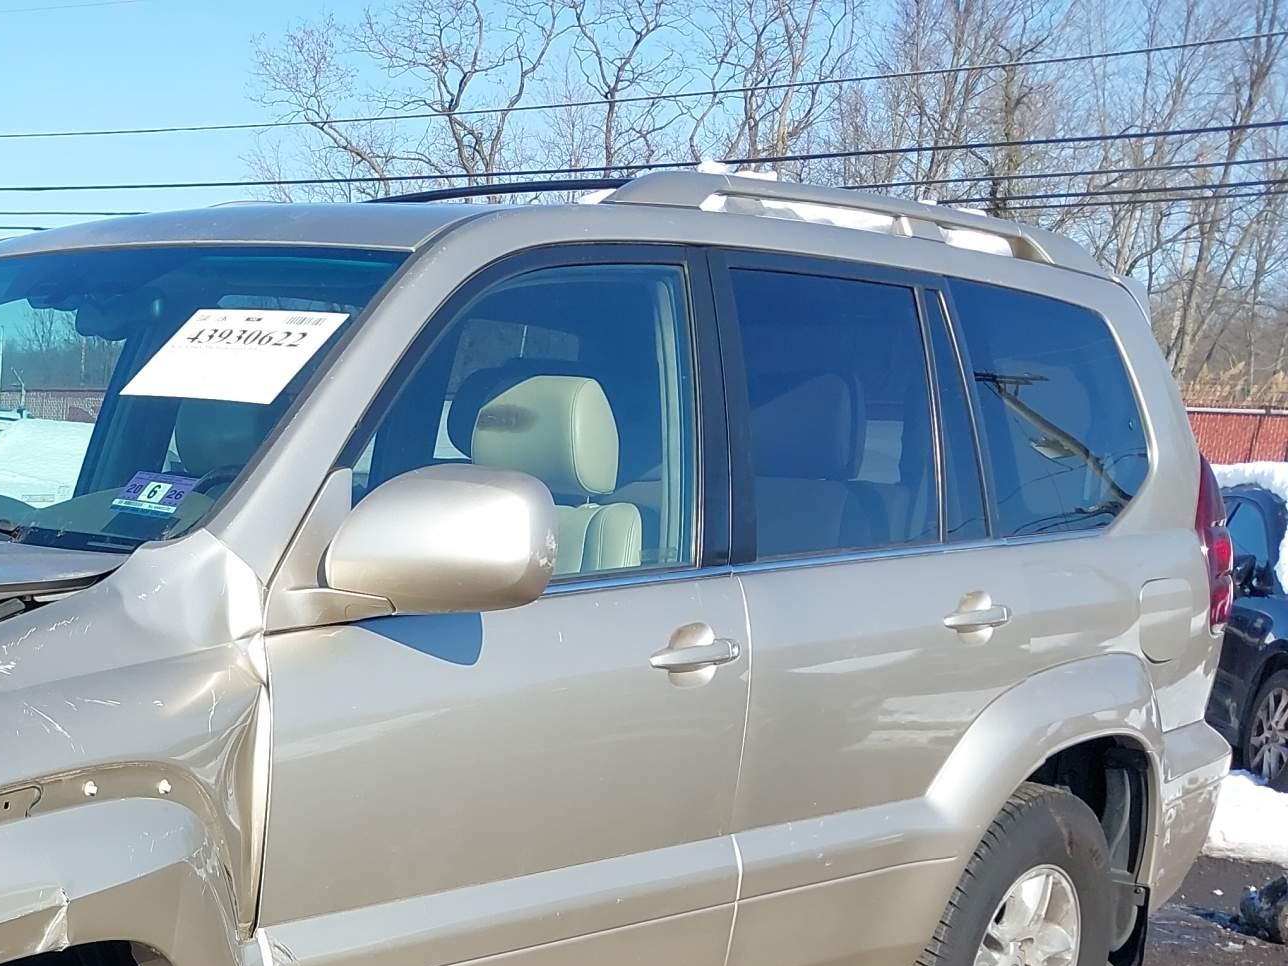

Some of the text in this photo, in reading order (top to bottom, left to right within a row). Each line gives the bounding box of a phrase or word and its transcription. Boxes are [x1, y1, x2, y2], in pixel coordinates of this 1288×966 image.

[186, 327, 308, 348] 43930622
[126, 483, 185, 500] 20 6 26
